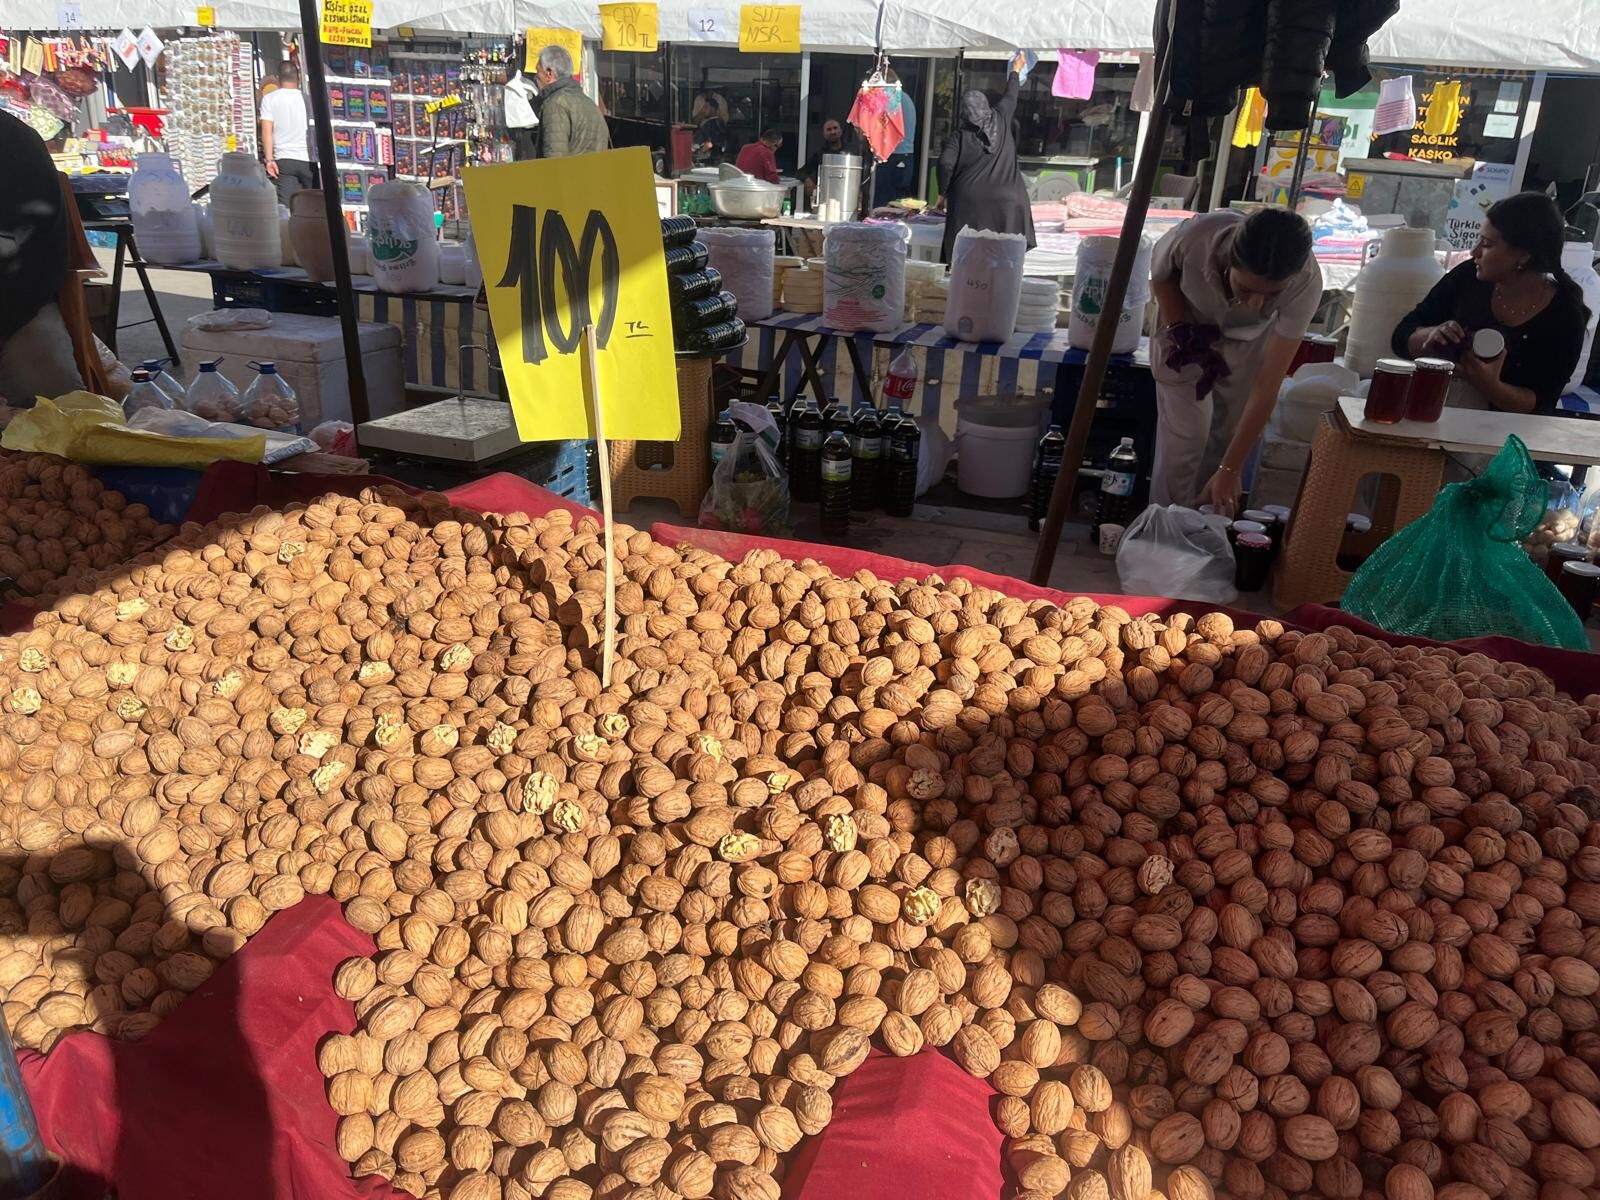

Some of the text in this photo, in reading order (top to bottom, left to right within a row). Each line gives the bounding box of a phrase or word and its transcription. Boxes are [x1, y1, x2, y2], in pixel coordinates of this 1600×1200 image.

[65, 12, 76, 23] 14
[699, 18, 715, 32] 12
[617, 23, 637, 47] 10
[1407, 148, 1453, 160] KASKO
[496, 204, 620, 365] 100
